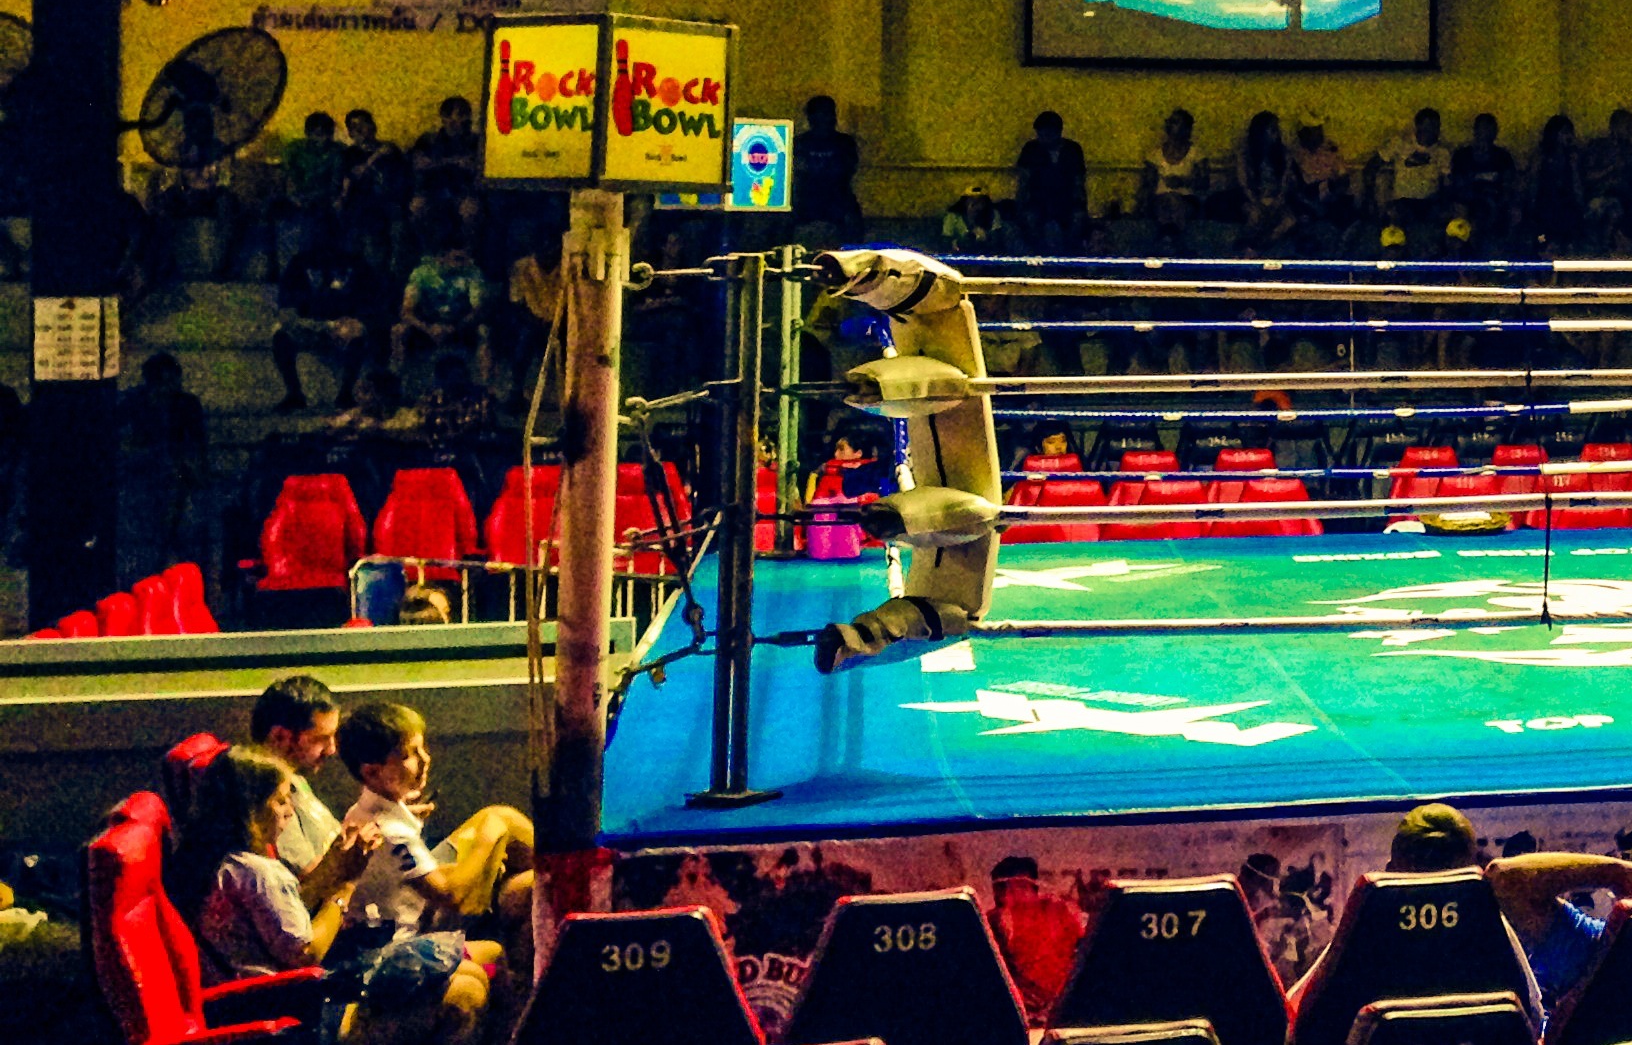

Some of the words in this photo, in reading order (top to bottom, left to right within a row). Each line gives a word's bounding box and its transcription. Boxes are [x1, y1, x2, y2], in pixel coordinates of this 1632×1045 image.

[1485, 714, 1614, 733] TOP
[1140, 910, 1206, 940] 307
[1399, 902, 1459, 931] 306
[873, 922, 938, 953] 308
[601, 939, 672, 972] 309
